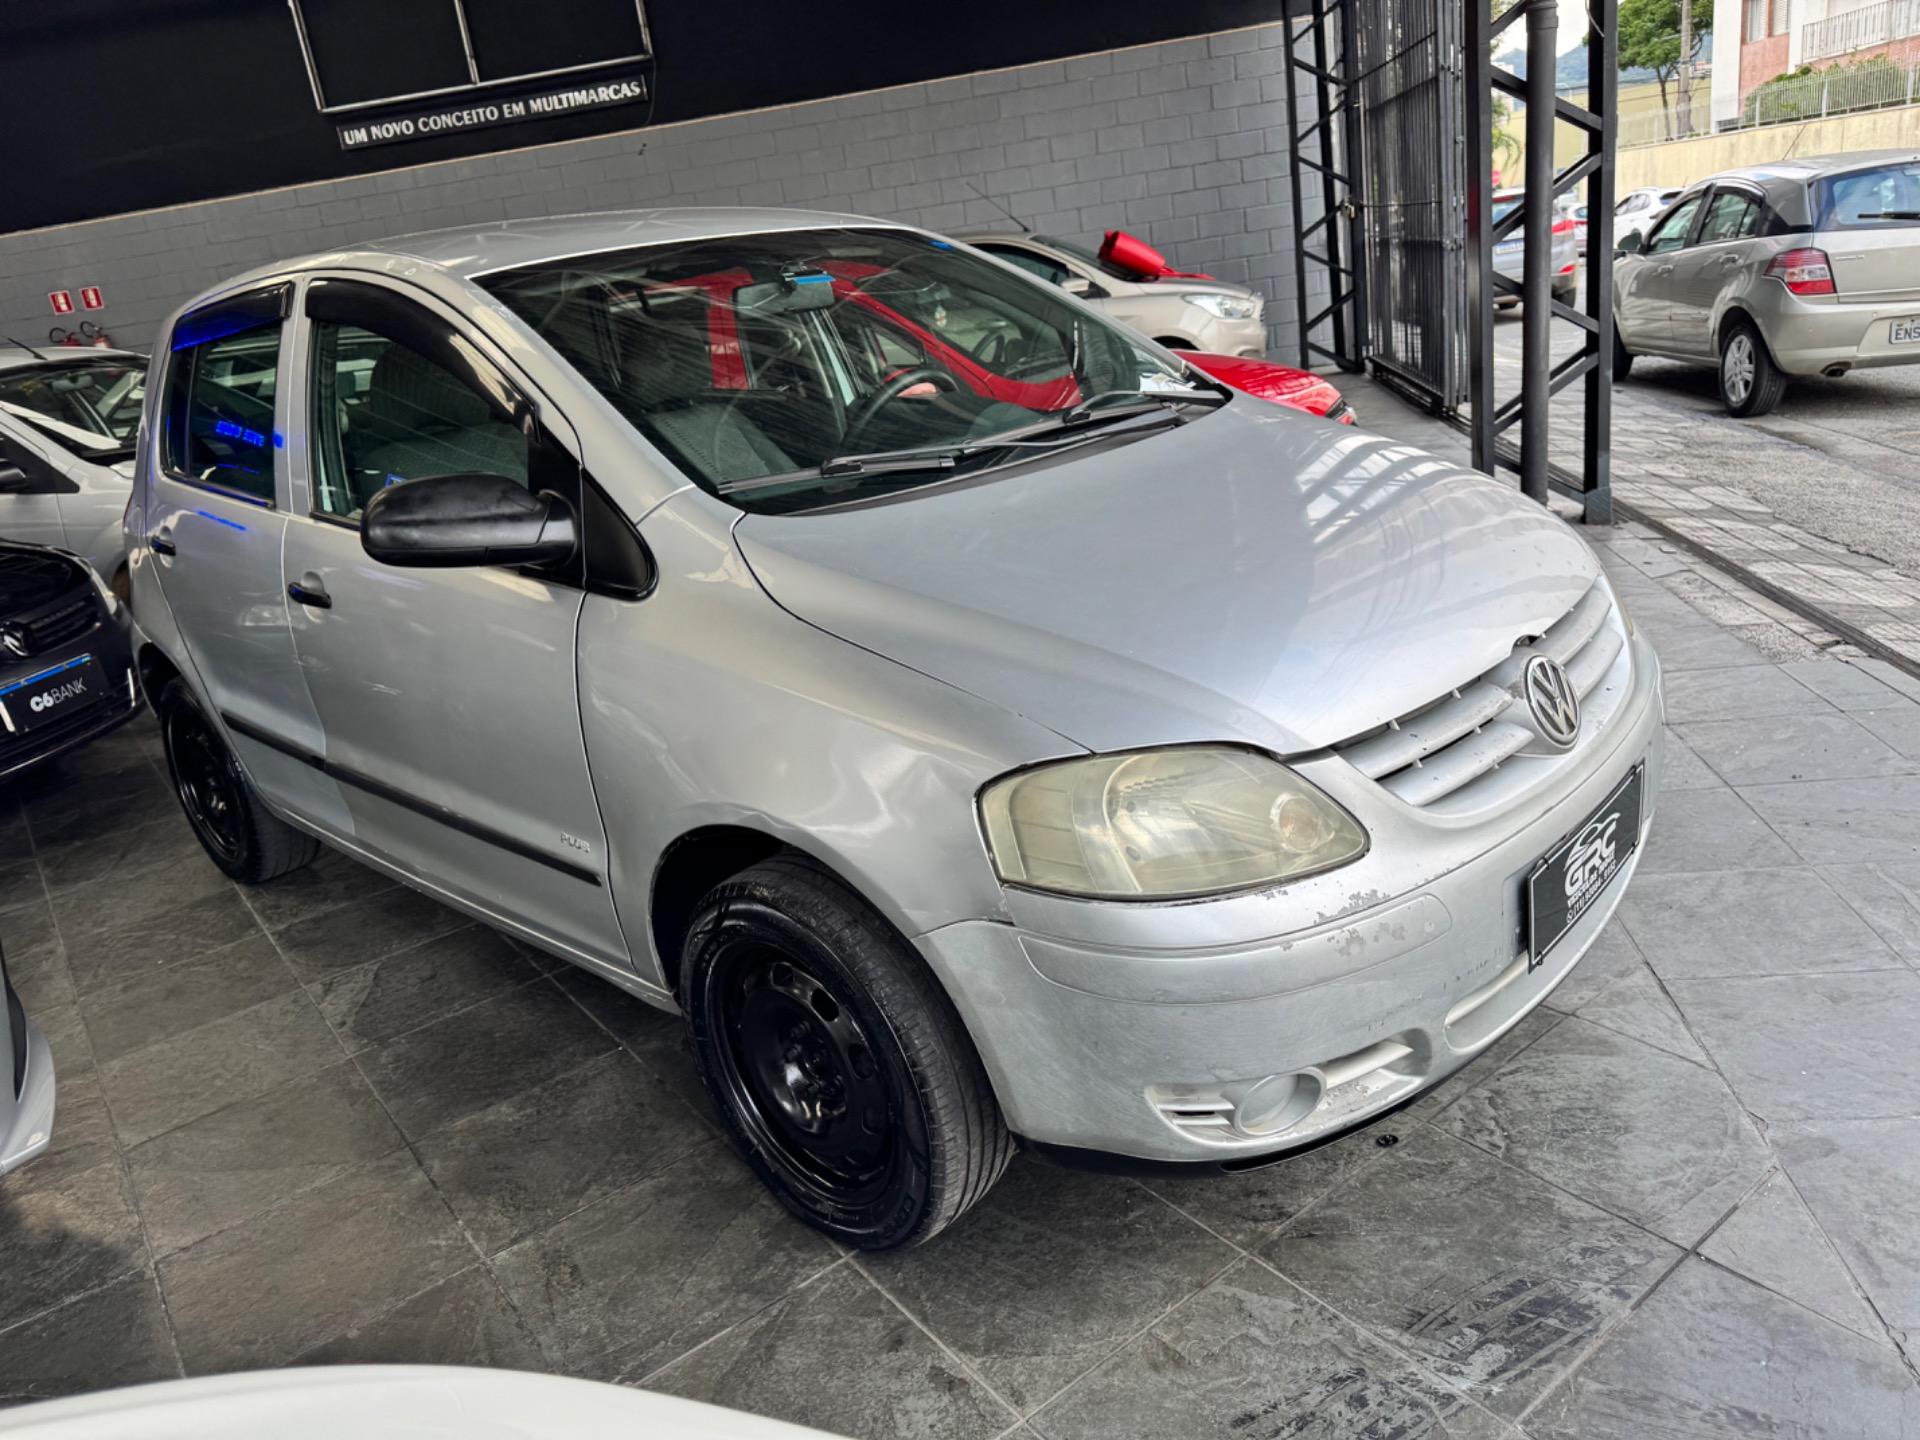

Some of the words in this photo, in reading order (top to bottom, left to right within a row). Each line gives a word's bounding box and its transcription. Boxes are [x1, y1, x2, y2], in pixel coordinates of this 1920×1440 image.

[343, 127, 369, 145] UM
[370, 119, 415, 140] NOVO
[417, 106, 499, 132] CONCEITO
[502, 101, 525, 118] EM
[529, 81, 641, 114] MULTIMARCAS
[1565, 820, 1617, 897] GRC
